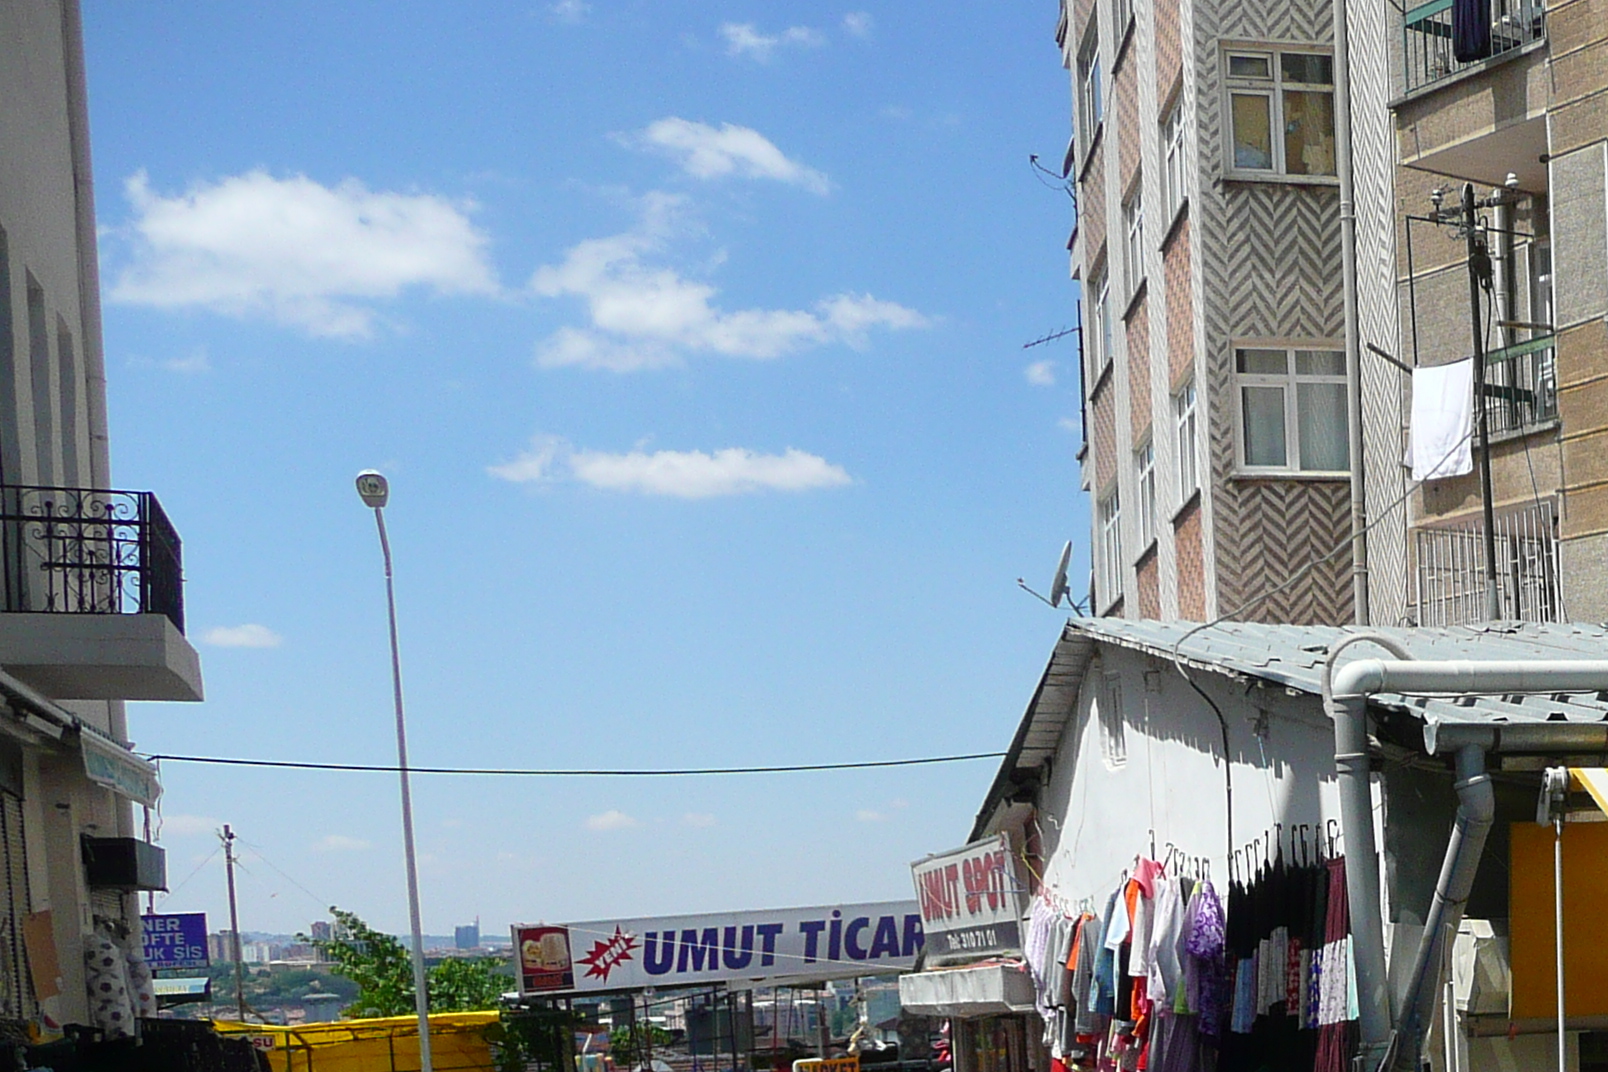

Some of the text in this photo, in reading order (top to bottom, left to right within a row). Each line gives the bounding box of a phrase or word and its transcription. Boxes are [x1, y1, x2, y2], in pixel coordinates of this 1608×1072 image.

[917, 850, 1007, 922] UMUT SPOT
[643, 923, 784, 976] UMUT
